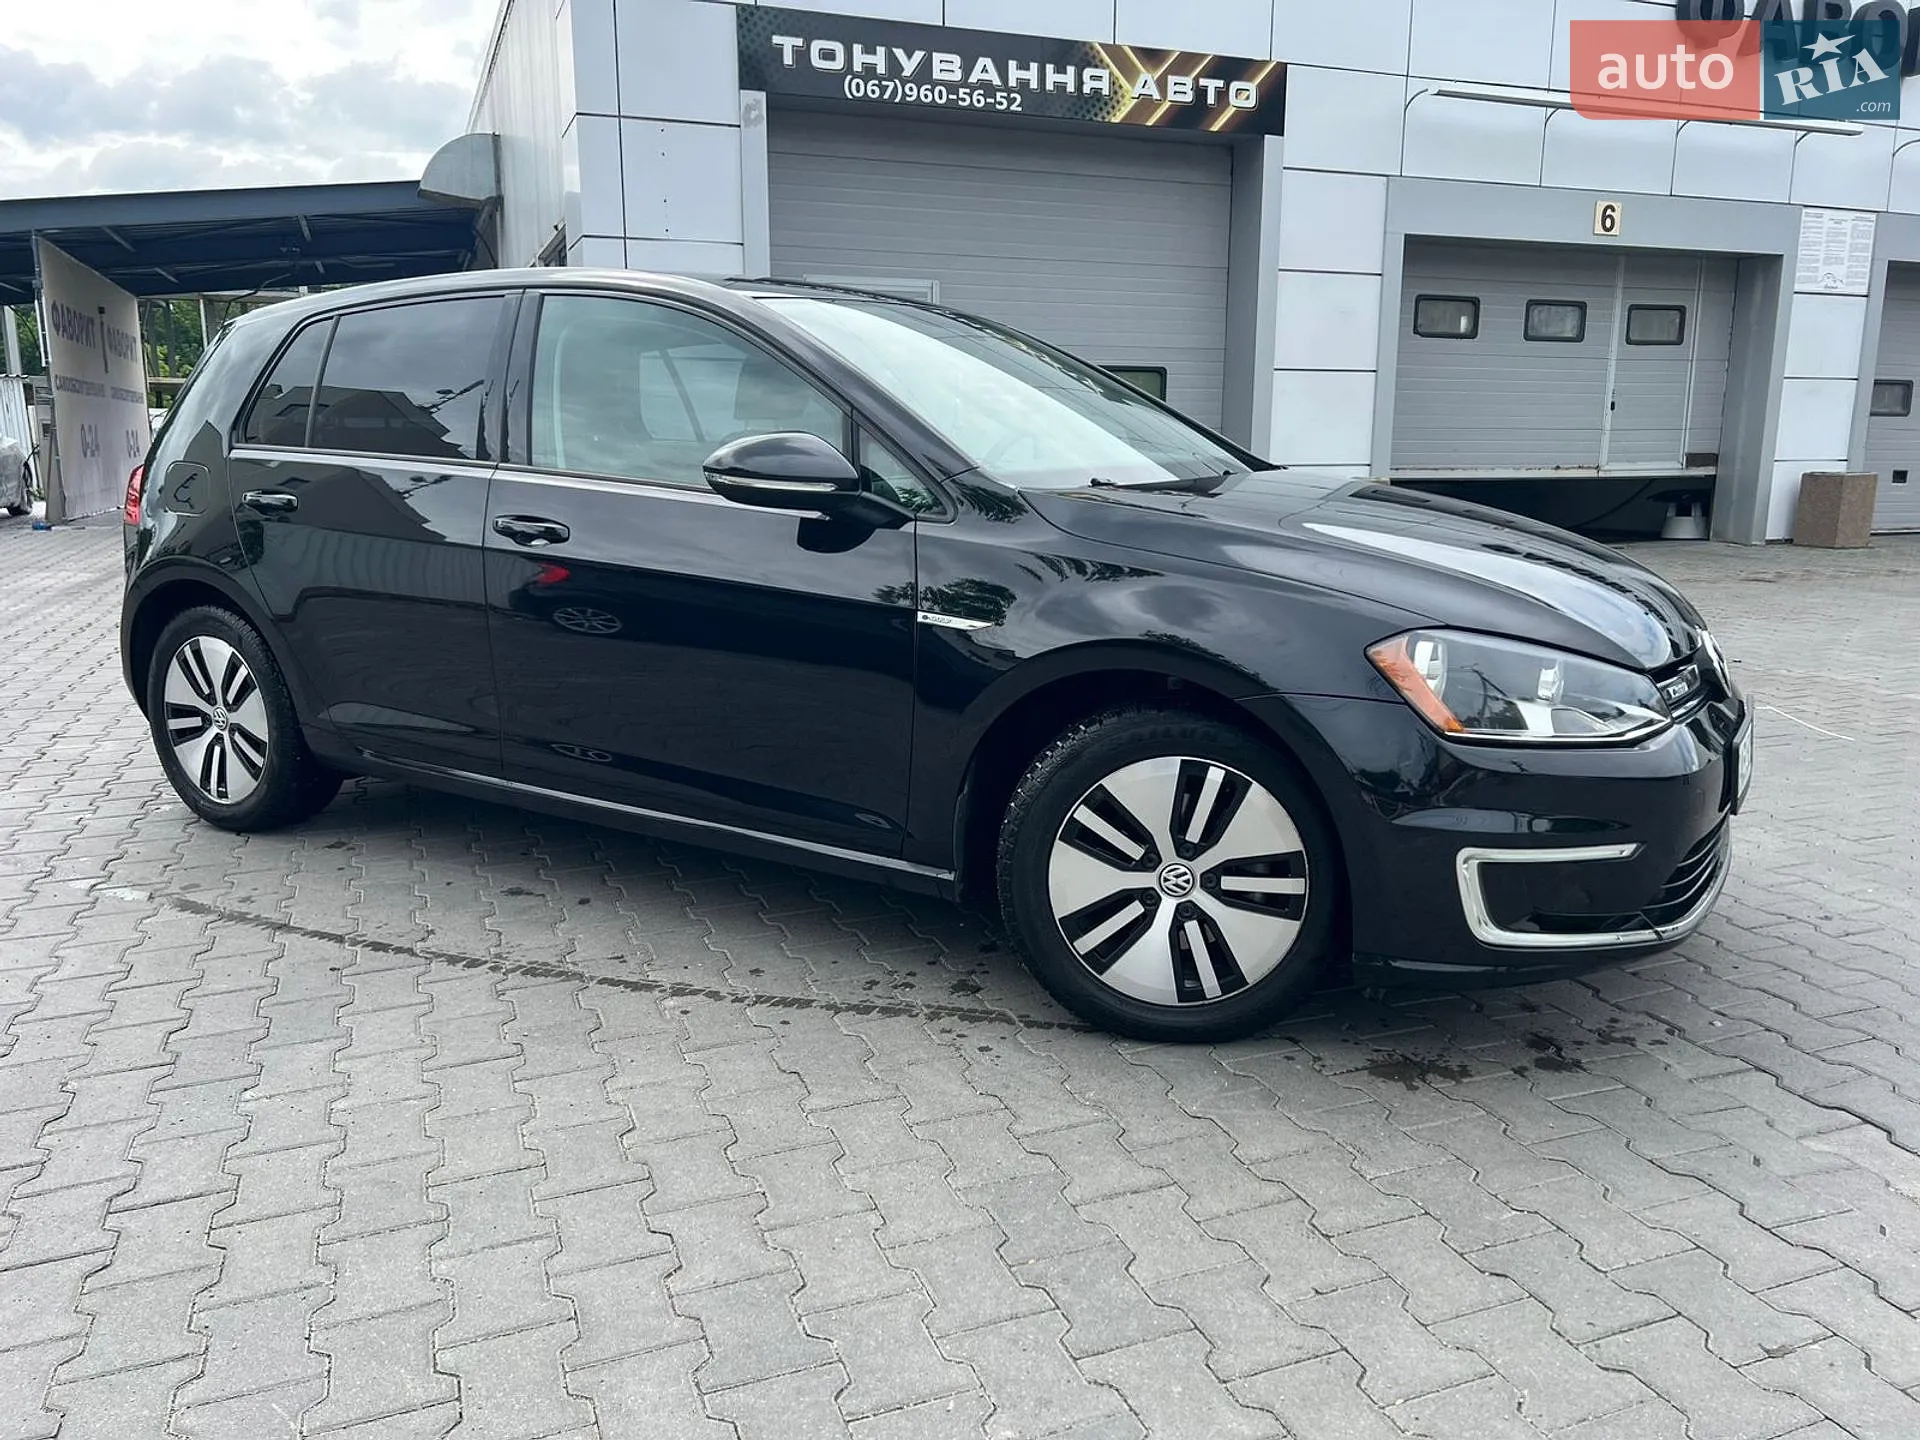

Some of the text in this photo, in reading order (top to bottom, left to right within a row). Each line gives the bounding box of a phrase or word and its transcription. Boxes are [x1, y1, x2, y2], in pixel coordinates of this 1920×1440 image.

[1676, 0, 1920, 77] ФАВО
[771, 34, 1258, 108] ТОНУВАННЯ АВТО
[844, 76, 1023, 112] (067)960-56-52
[1600, 204, 1616, 233] 6
[51, 300, 96, 349] ФАВОРИТ
